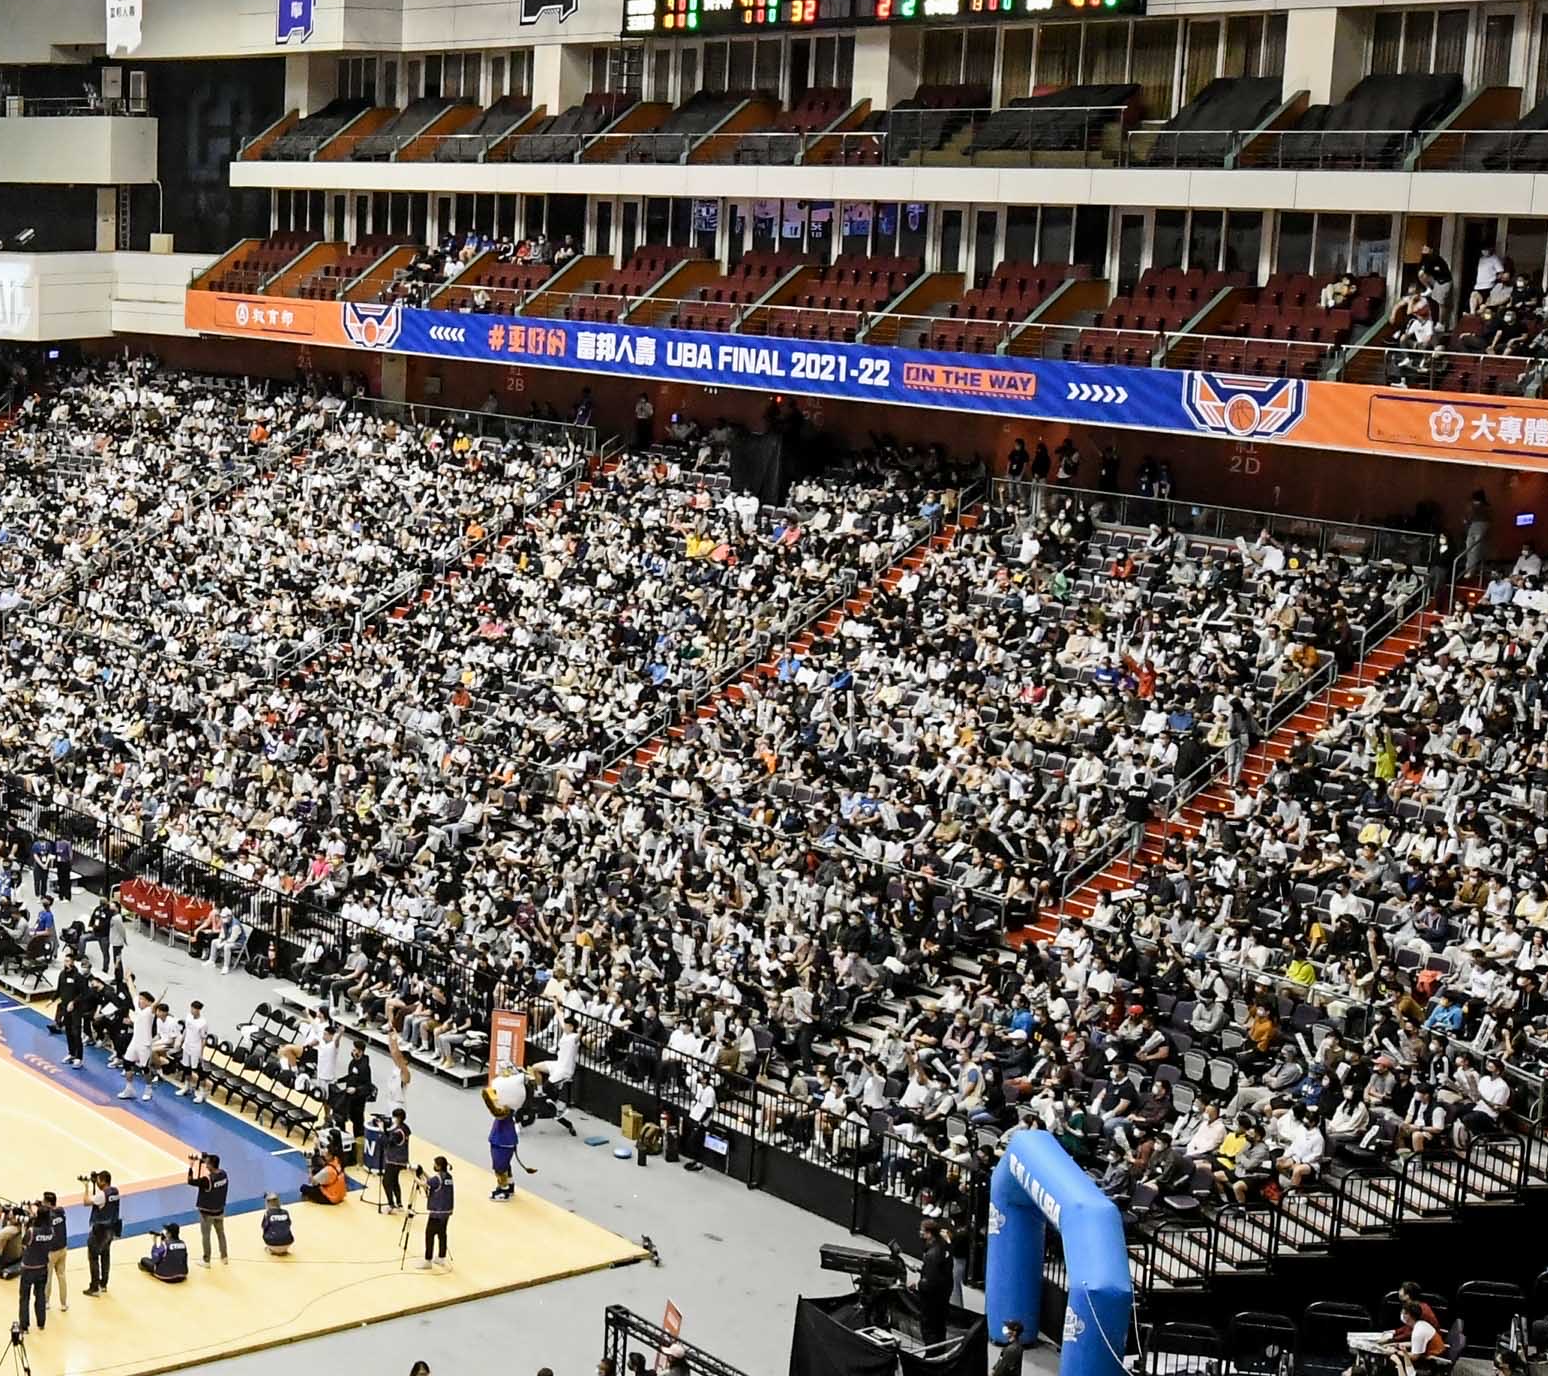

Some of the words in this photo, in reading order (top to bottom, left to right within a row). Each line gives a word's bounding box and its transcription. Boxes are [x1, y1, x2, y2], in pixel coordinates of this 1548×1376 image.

[577, 331, 656, 366] 富邦人壽
[666, 346, 714, 370] UBA
[718, 346, 786, 377] FINAL
[790, 351, 891, 387] 2021-22
[906, 366, 935, 384] ON
[942, 370, 982, 389] THE
[989, 374, 1033, 392] WAY
[506, 377, 525, 392] 2B
[1228, 455, 1262, 475] 2D
